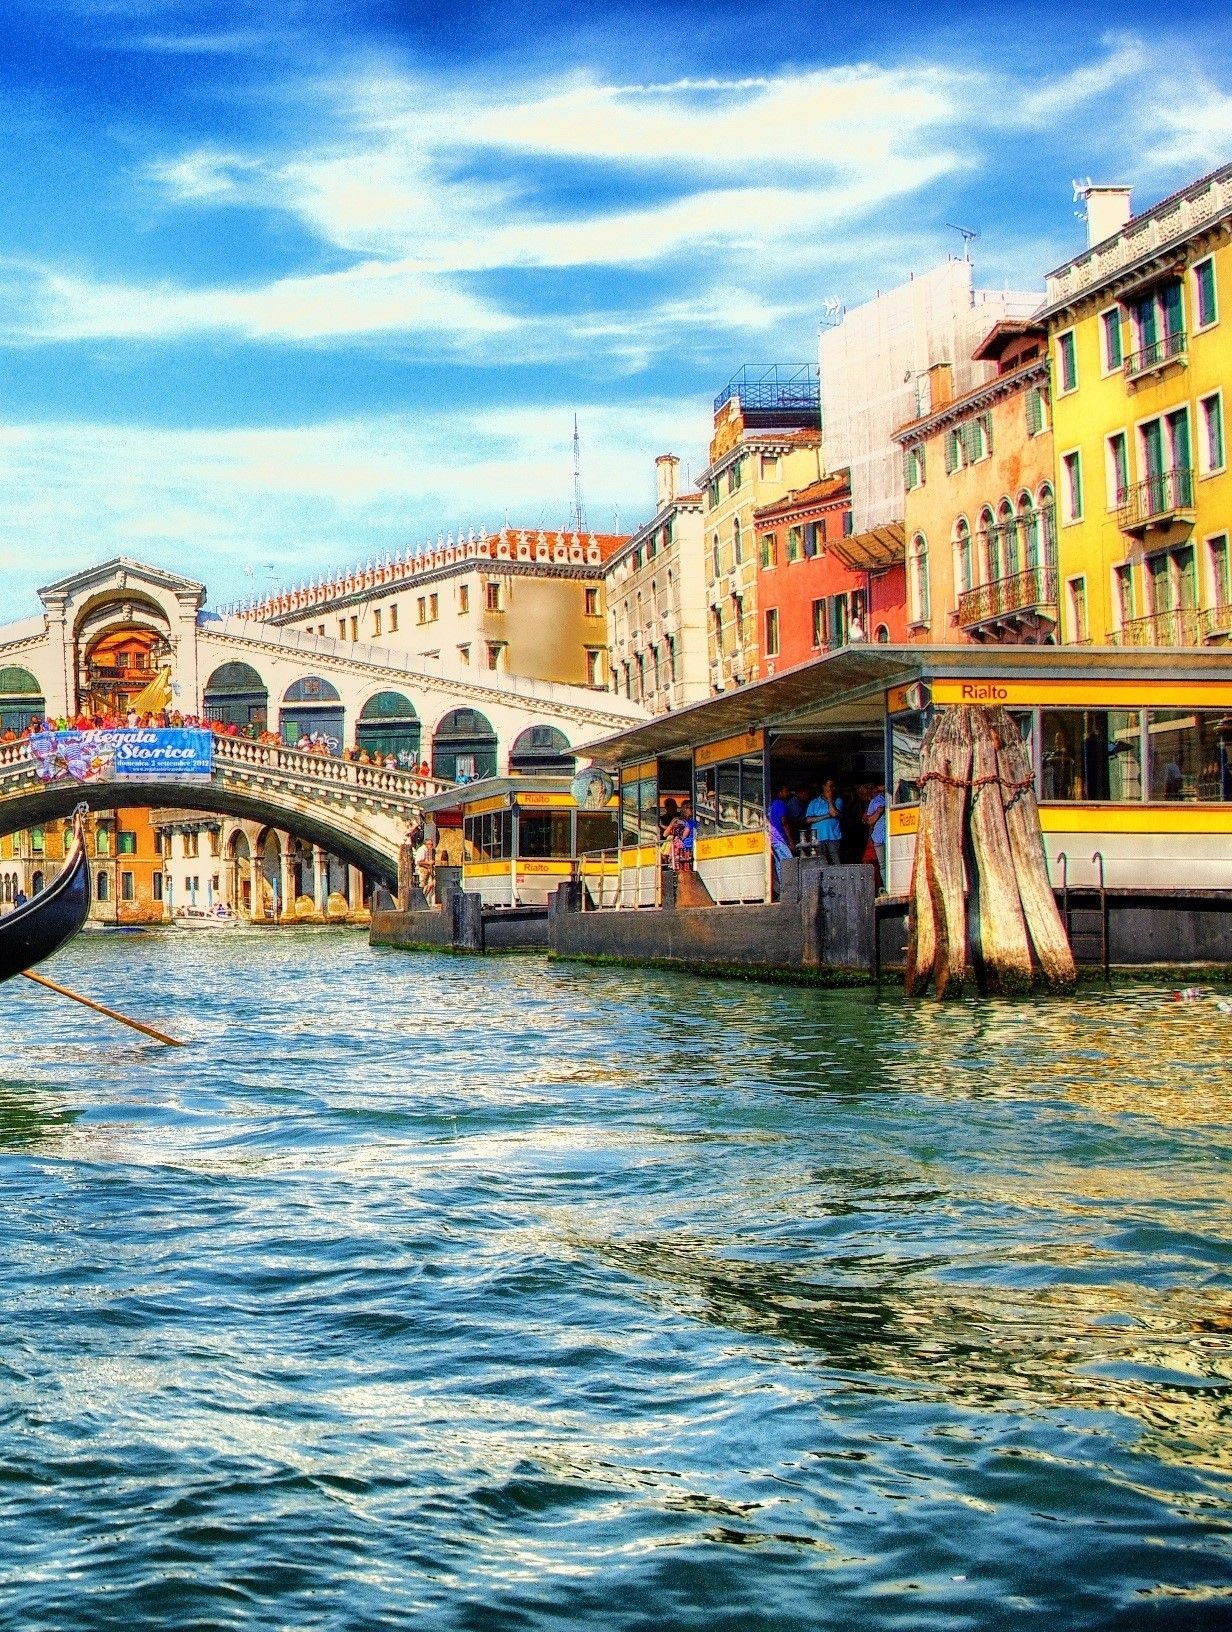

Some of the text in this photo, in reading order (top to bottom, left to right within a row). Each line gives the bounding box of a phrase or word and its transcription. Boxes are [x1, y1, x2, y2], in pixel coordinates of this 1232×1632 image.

[962, 685, 1007, 699] Rialto
[117, 743, 196, 759] Storica
[524, 794, 550, 803] Rialto
[524, 863, 549, 872] Rialto
